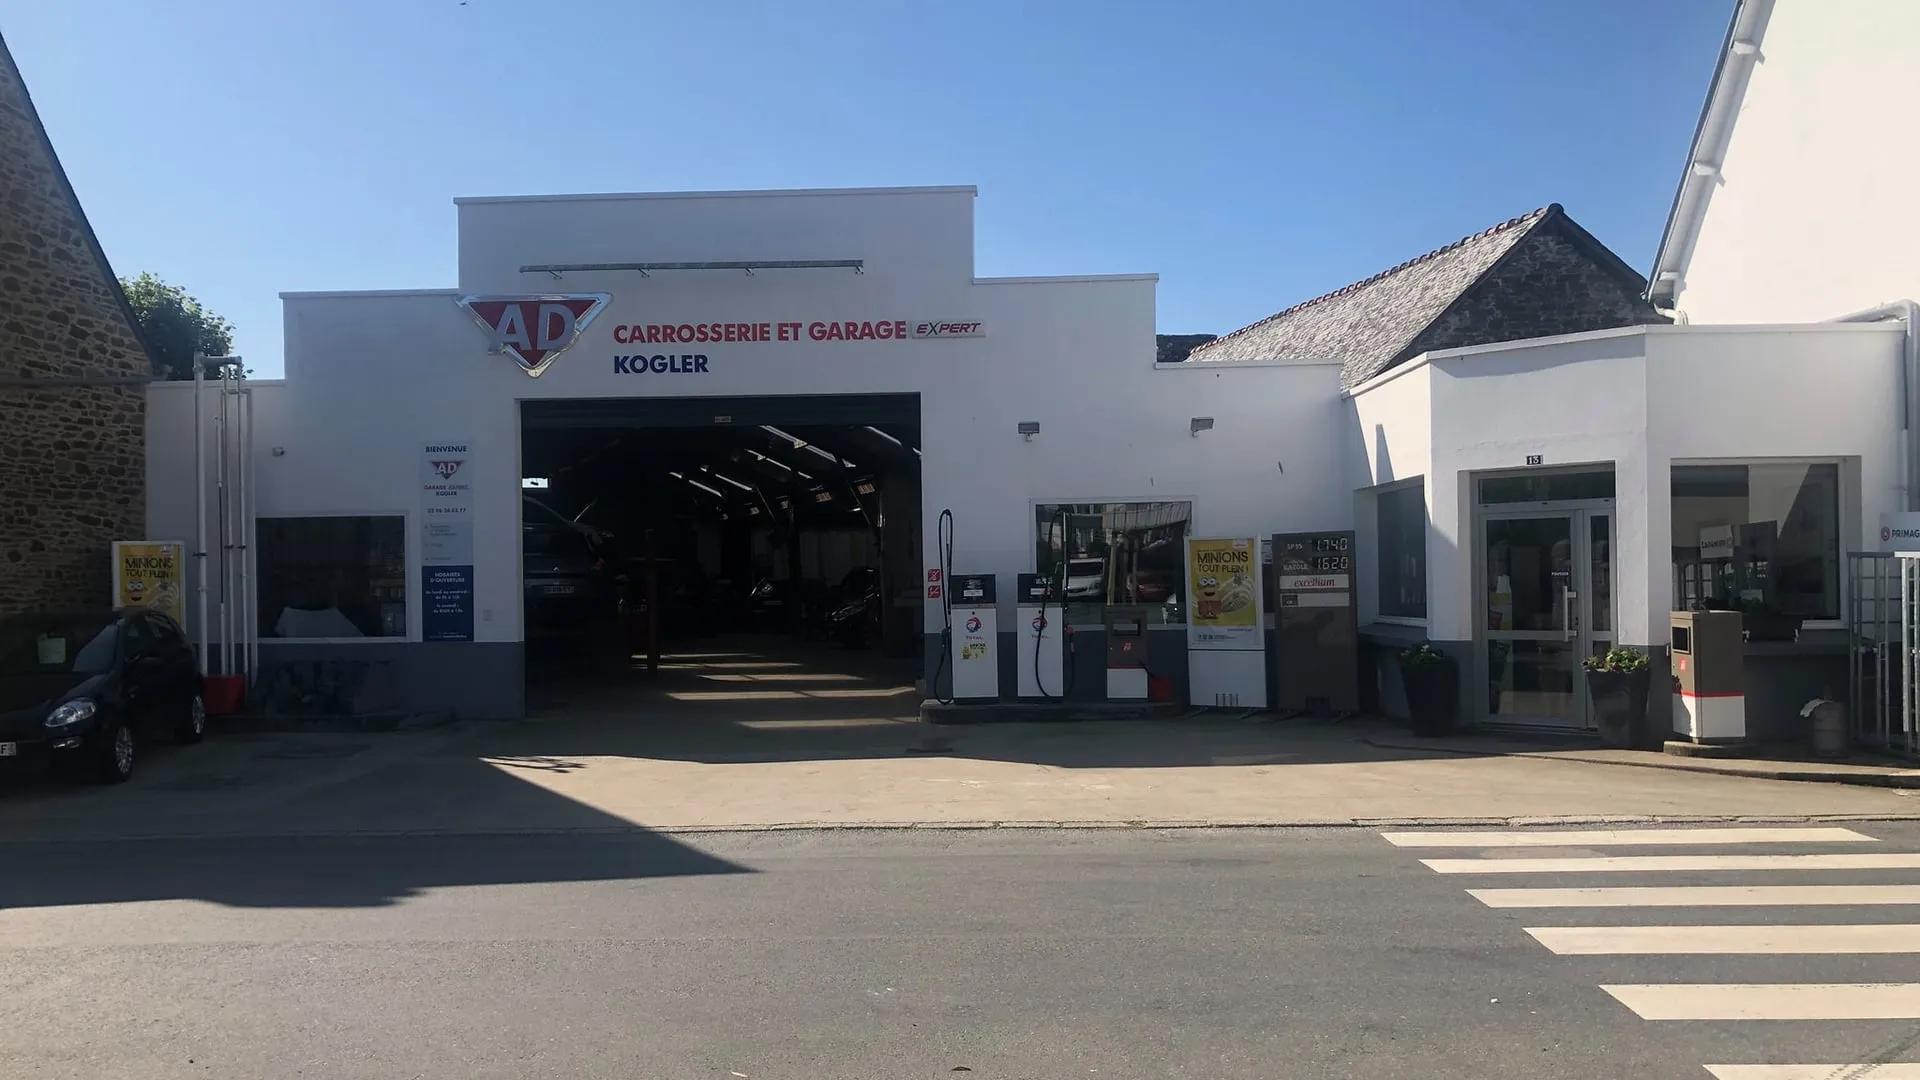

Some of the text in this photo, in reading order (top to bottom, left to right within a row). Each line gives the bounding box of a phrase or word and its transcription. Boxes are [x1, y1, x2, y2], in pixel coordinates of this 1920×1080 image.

[488, 303, 577, 353] AD
[613, 319, 907, 345] CARROSSERIE ET GARAGE
[613, 354, 709, 375] KOGLER
[425, 445, 467, 453] BIENVENUE
[438, 462, 457, 474] AD
[125, 557, 174, 569] MINIONS
[1197, 551, 1249, 563] MINIONS
[125, 568, 148, 577] TOUT
[1199, 564, 1220, 573] TOUT
[1222, 564, 1244, 573] PLEIN
[1294, 576, 1335, 587] excellium
